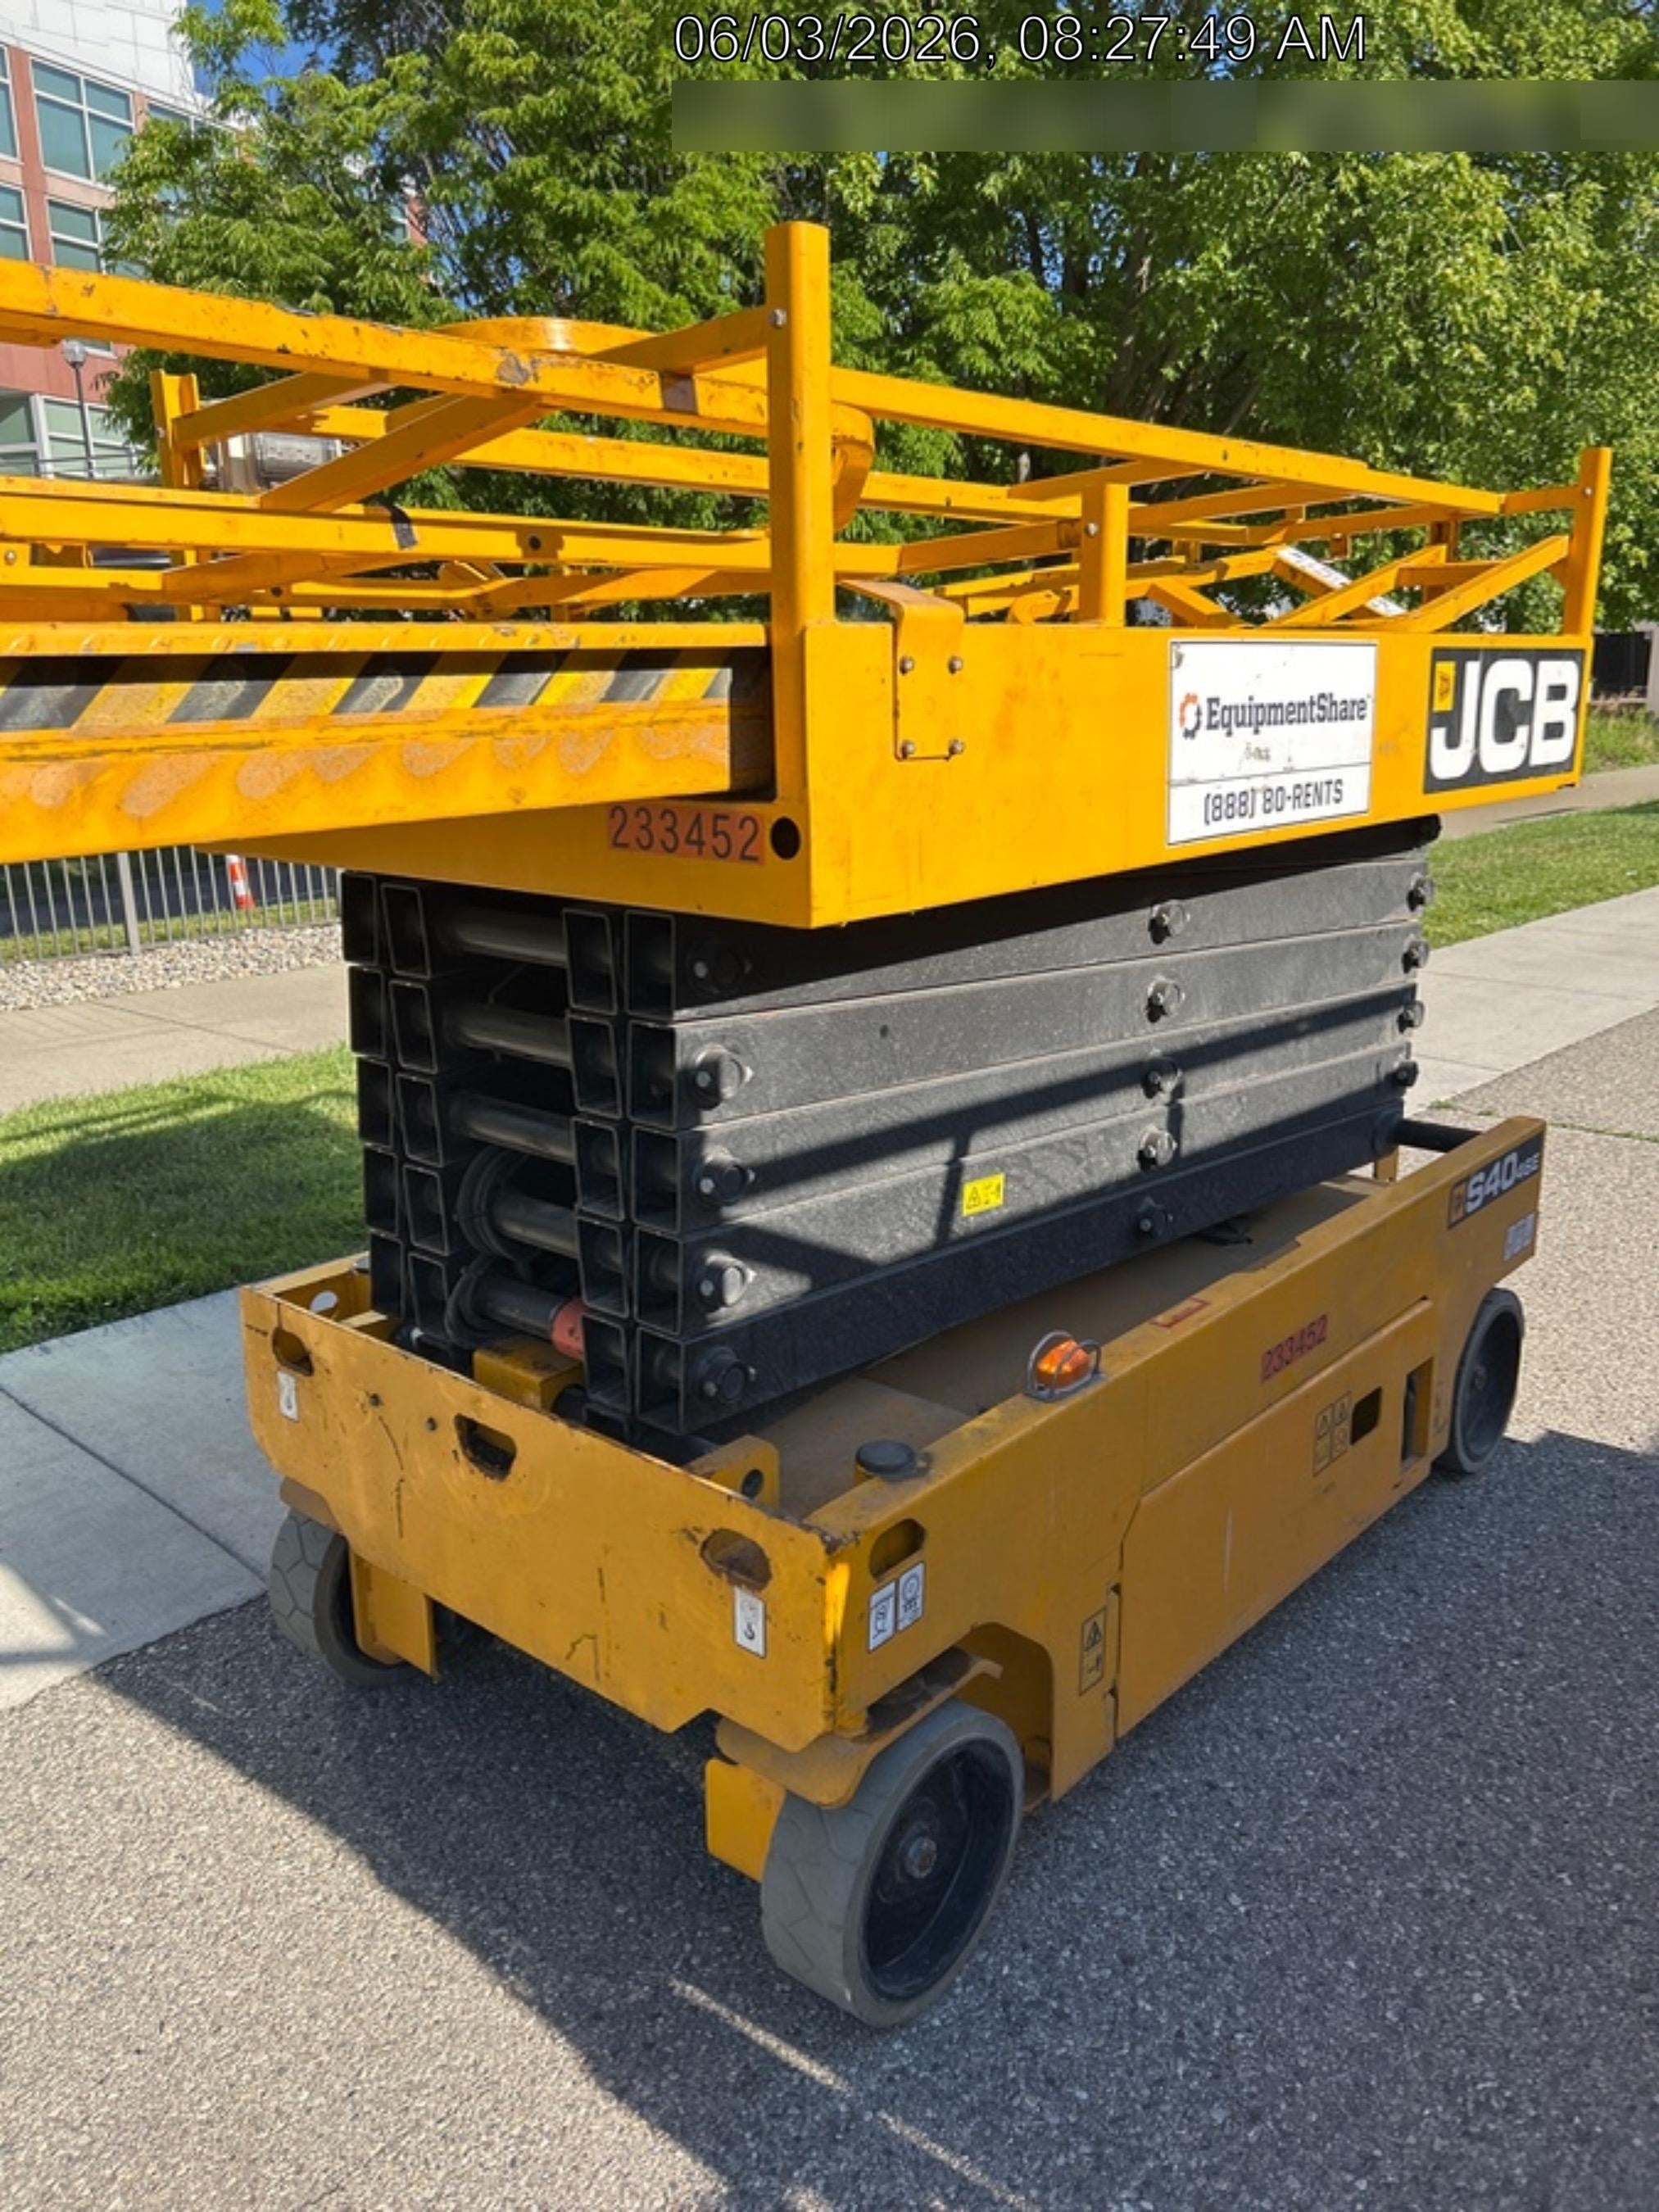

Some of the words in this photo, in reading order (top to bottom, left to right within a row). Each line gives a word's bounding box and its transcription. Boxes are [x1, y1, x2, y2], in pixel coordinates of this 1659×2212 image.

[1206, 692, 1368, 737] EquipmentShare
[1429, 658, 1580, 781] JCB
[1203, 786, 1258, 826] (888)
[1262, 778, 1344, 814] 80-RENTS
[609, 805, 760, 861] 233452
[1262, 1314, 1327, 1380] 233452
